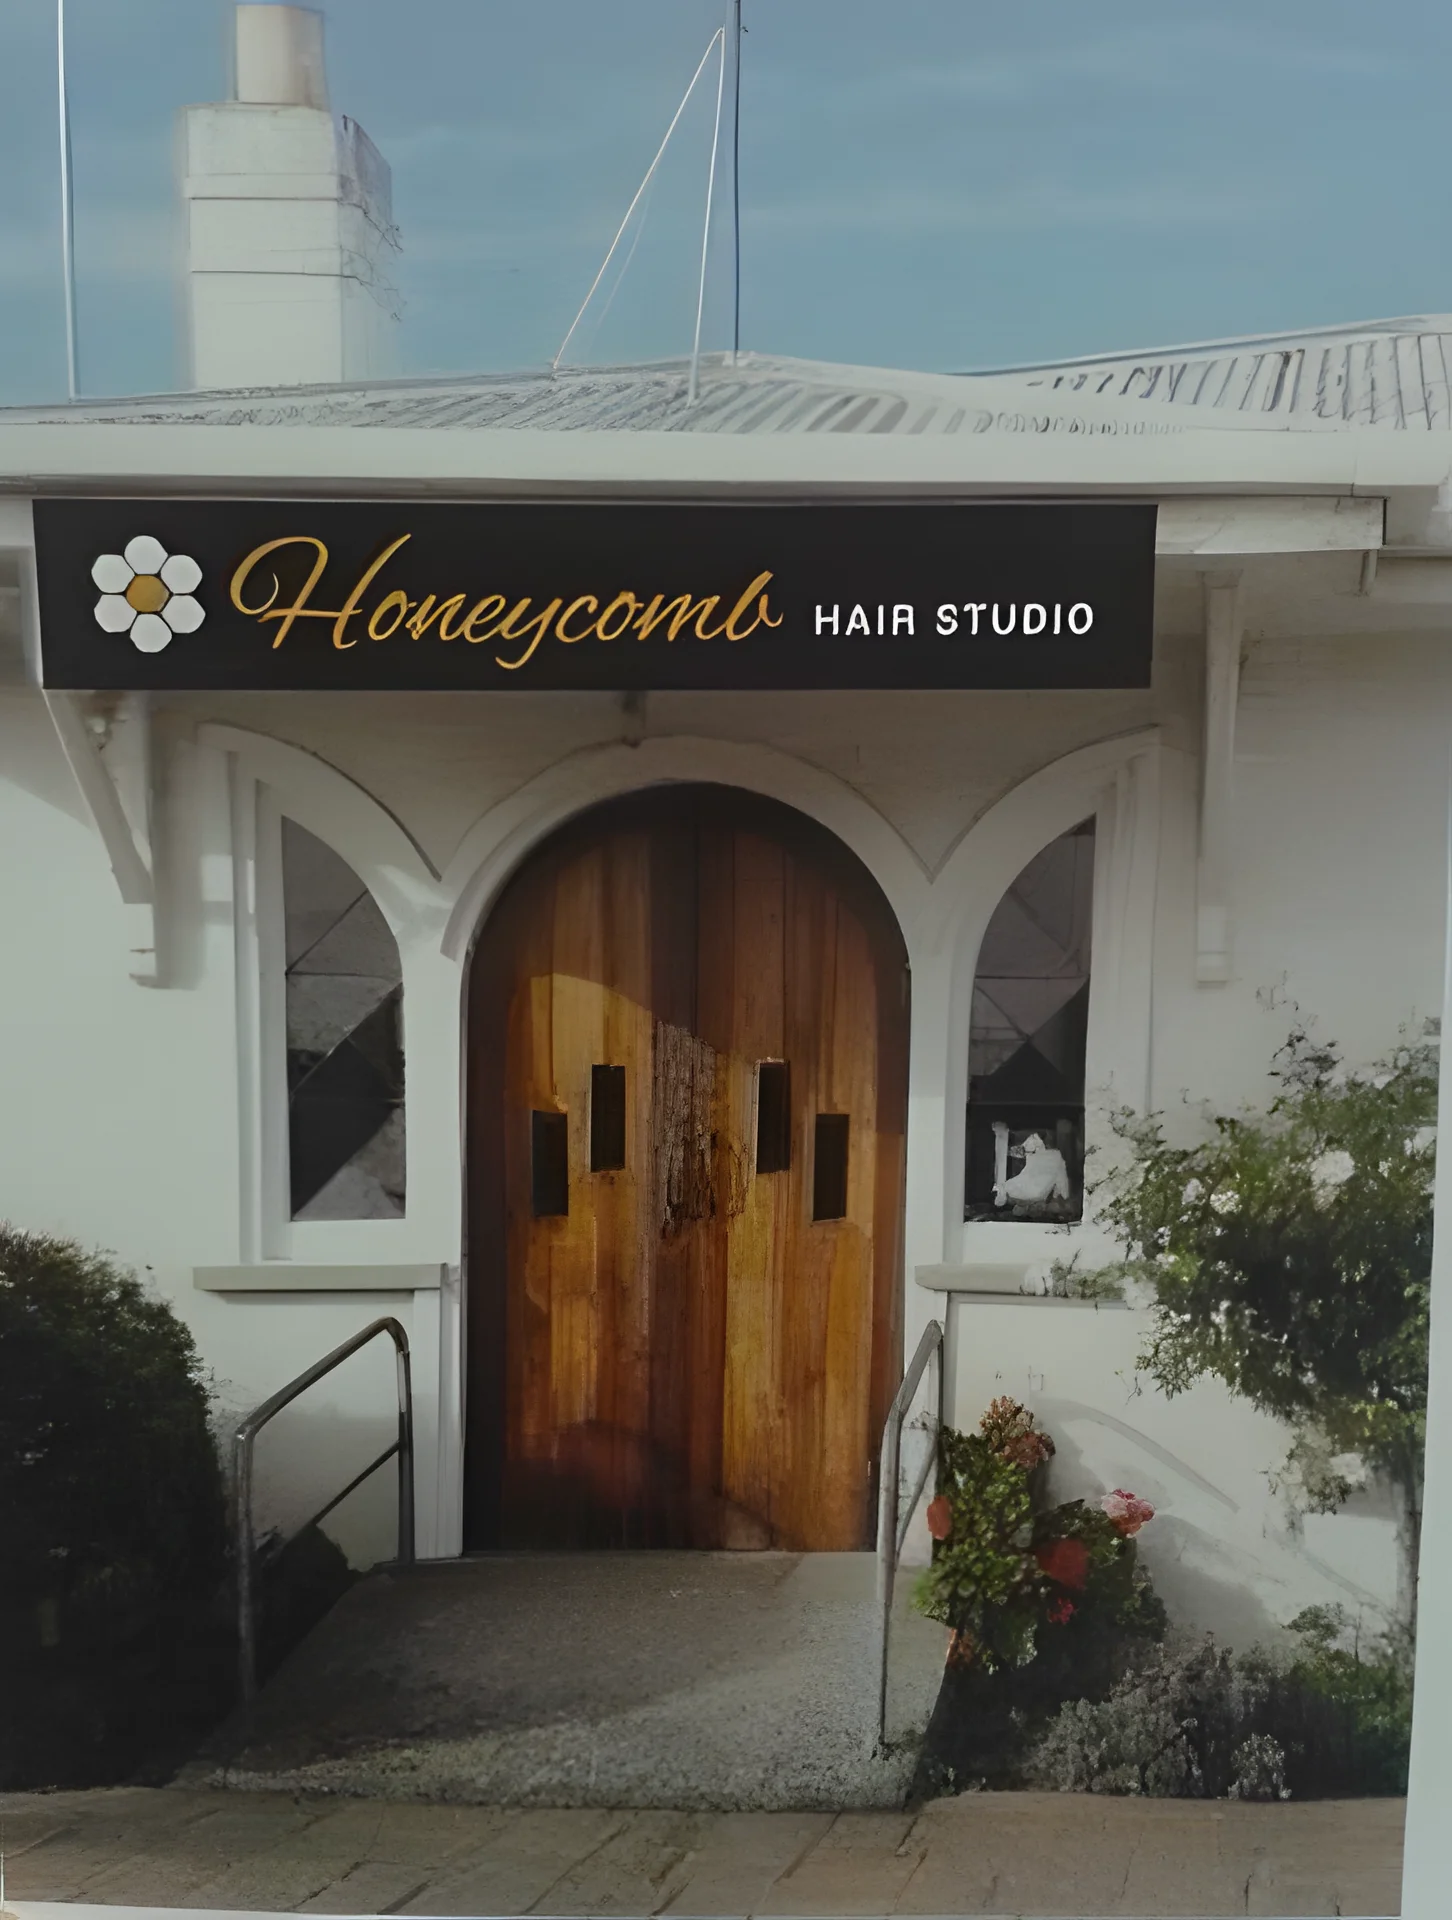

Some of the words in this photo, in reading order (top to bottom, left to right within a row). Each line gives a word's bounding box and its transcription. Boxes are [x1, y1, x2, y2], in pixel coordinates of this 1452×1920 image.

[230, 533, 784, 670] Honeycomb
[814, 603, 915, 636] HAIR
[935, 602, 1094, 636] STUDIO
